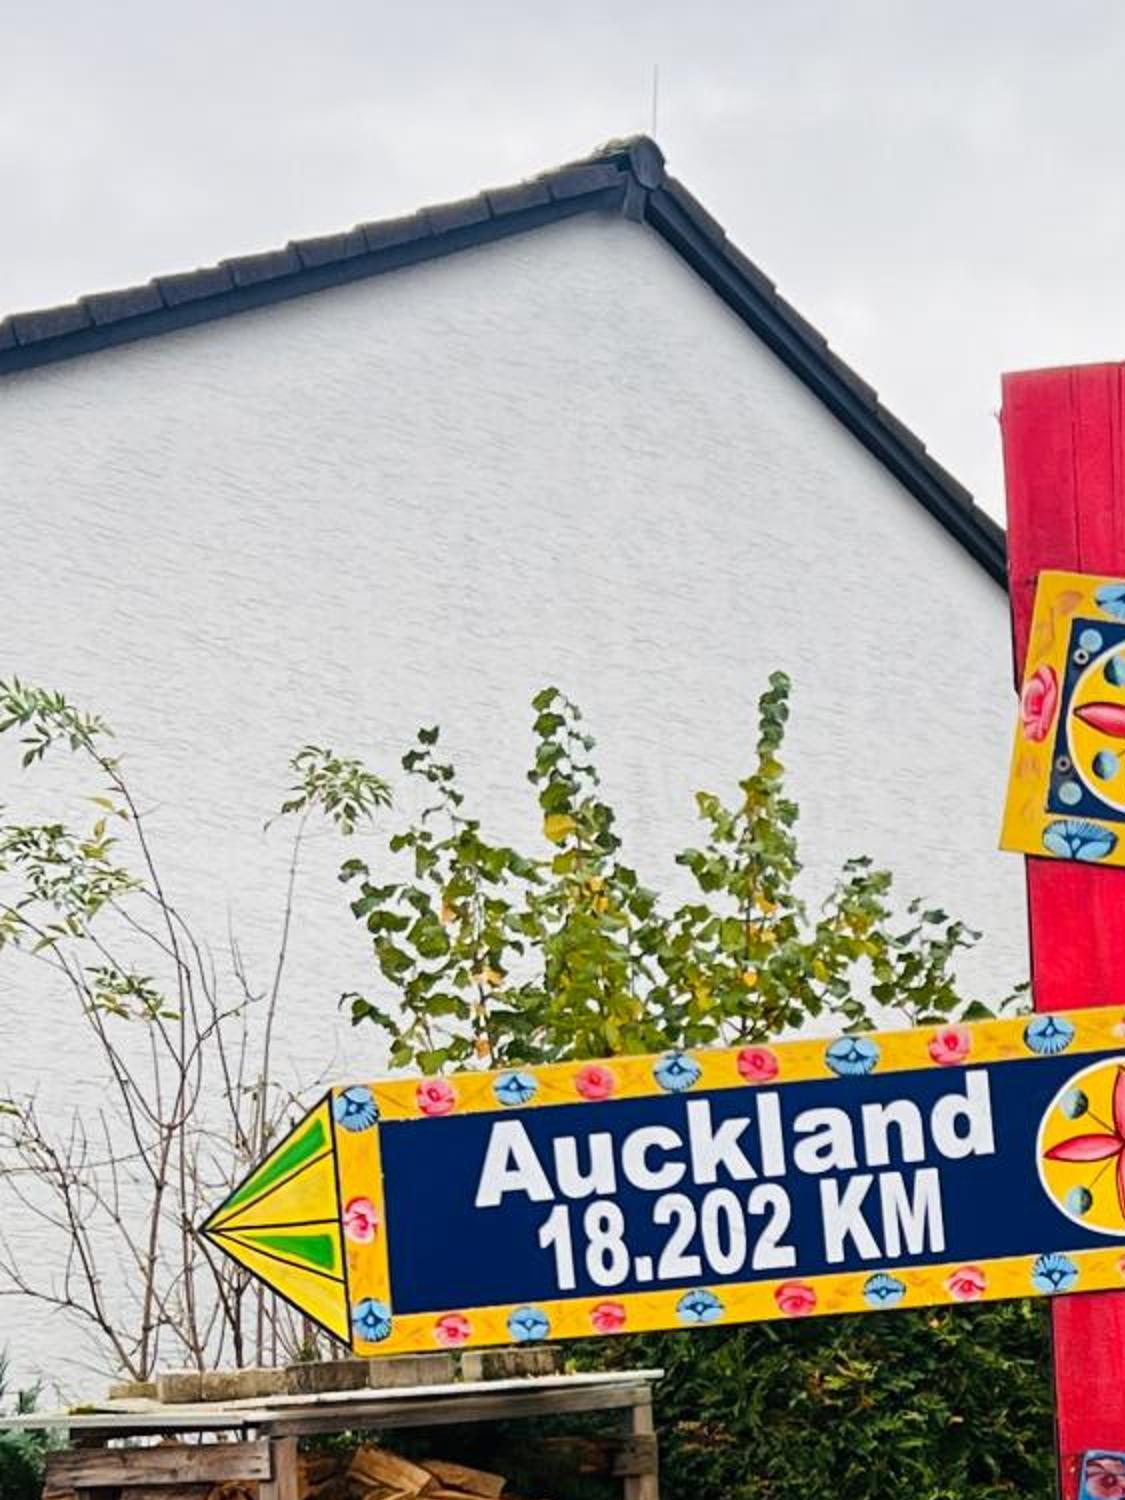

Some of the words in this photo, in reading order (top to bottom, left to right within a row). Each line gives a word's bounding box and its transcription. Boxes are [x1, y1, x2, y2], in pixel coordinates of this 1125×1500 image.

[475, 1069, 996, 1207] Auckland
[538, 1183, 796, 1290] 18.202
[820, 1167, 946, 1263] KM
